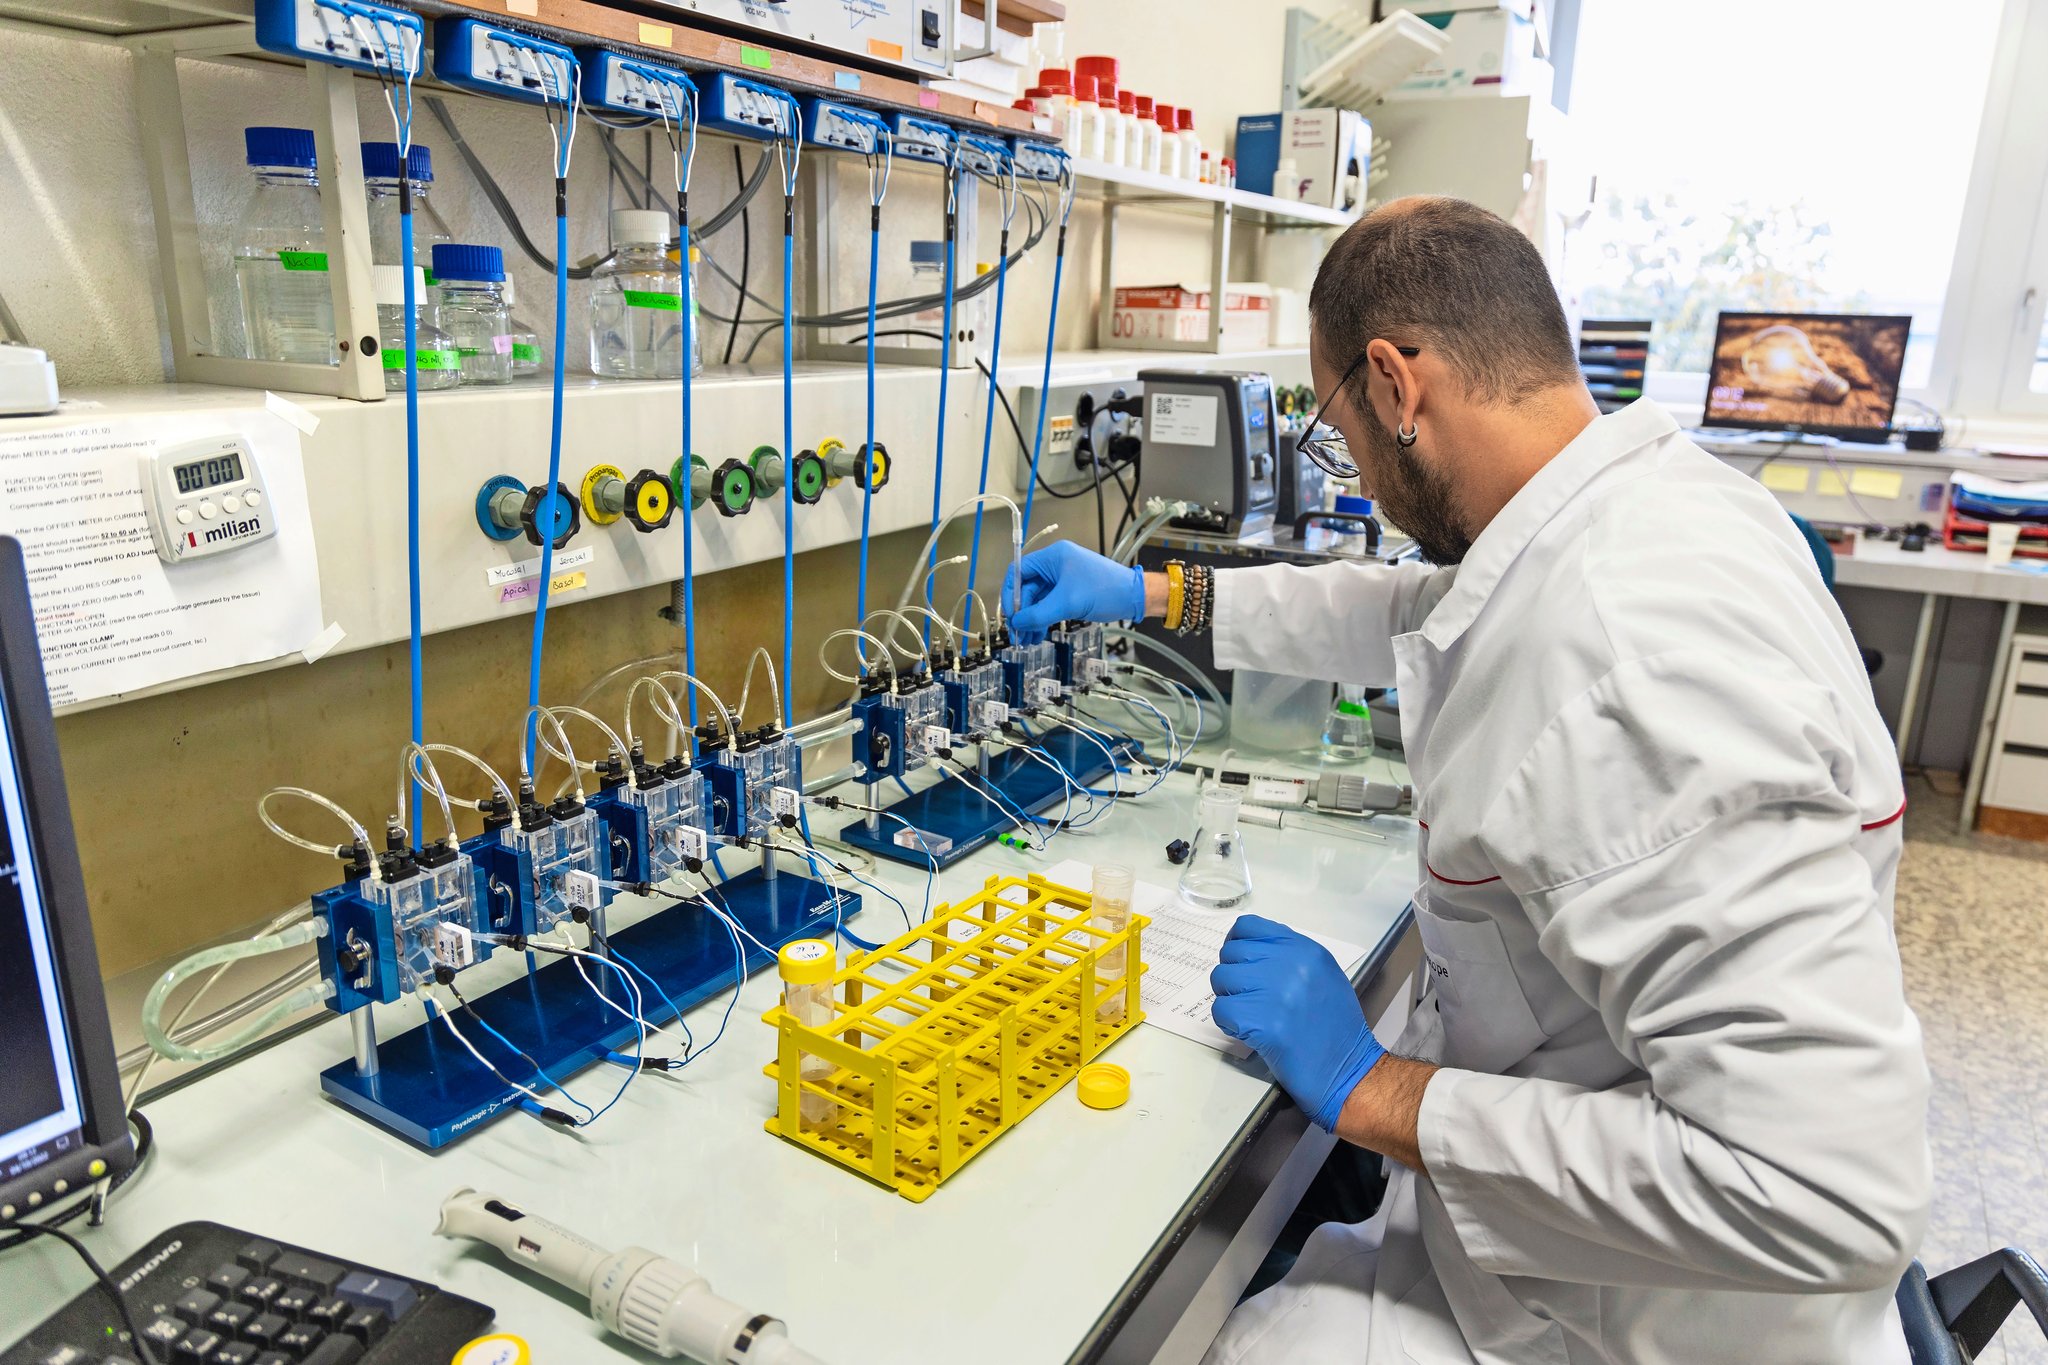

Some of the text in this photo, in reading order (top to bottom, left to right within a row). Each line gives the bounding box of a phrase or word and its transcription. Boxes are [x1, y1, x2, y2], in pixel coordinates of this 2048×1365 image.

[23, 450, 50, 459] METER
[5, 475, 46, 486] FUNCTION
[58, 471, 79, 480] OPEN
[487, 475, 519, 491] Pressluft
[589, 467, 619, 483] Propangas
[6, 485, 35, 494] METER
[45, 480, 79, 490] VOLTAGE
[10, 499, 54, 511] Compensate
[55, 497, 69, 505] with
[70, 494, 100, 503] OFFSET
[14, 527, 32, 535] After
[78, 517, 103, 527] METER
[114, 510, 147, 521] CURRENT
[205, 518, 260, 543] milian
[23, 543, 44, 551] urrent
[46, 538, 68, 547] should
[69, 537, 84, 545] read
[85, 534, 100, 542] from
[56, 547, 74, 555] much
[76, 541, 108, 551] resistance
[73, 559, 92, 569] press
[94, 555, 113, 564] PUSH
[126, 550, 140, 559] ADJ
[495, 552, 587, 578] Mucosal Serosal
[31, 591, 49, 599] djust
[63, 585, 85, 594] FLUID
[101, 578, 122, 587] COMP
[503, 583, 530, 598] Apical
[34, 603, 70, 614] UNCTION
[81, 598, 101, 607] ZERO
[55, 611, 75, 619] tissue
[74, 621, 107, 632] VOLTAGE
[109, 617, 126, 626] (read
[126, 614, 136, 622] the
[171, 603, 192, 612] voltage
[193, 597, 222, 608] generated
[38, 619, 73, 631] UNCTION
[84, 613, 105, 621] OPEN
[43, 641, 78, 654] UNCTION
[89, 634, 115, 645] CLAMP
[74, 644, 109, 656] VOLTAGE
[110, 638, 129, 649] (verify
[129, 636, 142, 644] that
[143, 633, 159, 641] reads
[80, 658, 116, 670] CURRENT
[127, 652, 141, 660] read
[141, 649, 152, 657] the
[152, 645, 170, 654] circuit
[451, 1108, 487, 1133] Physiologic
[119, 1240, 183, 1292] enovo
